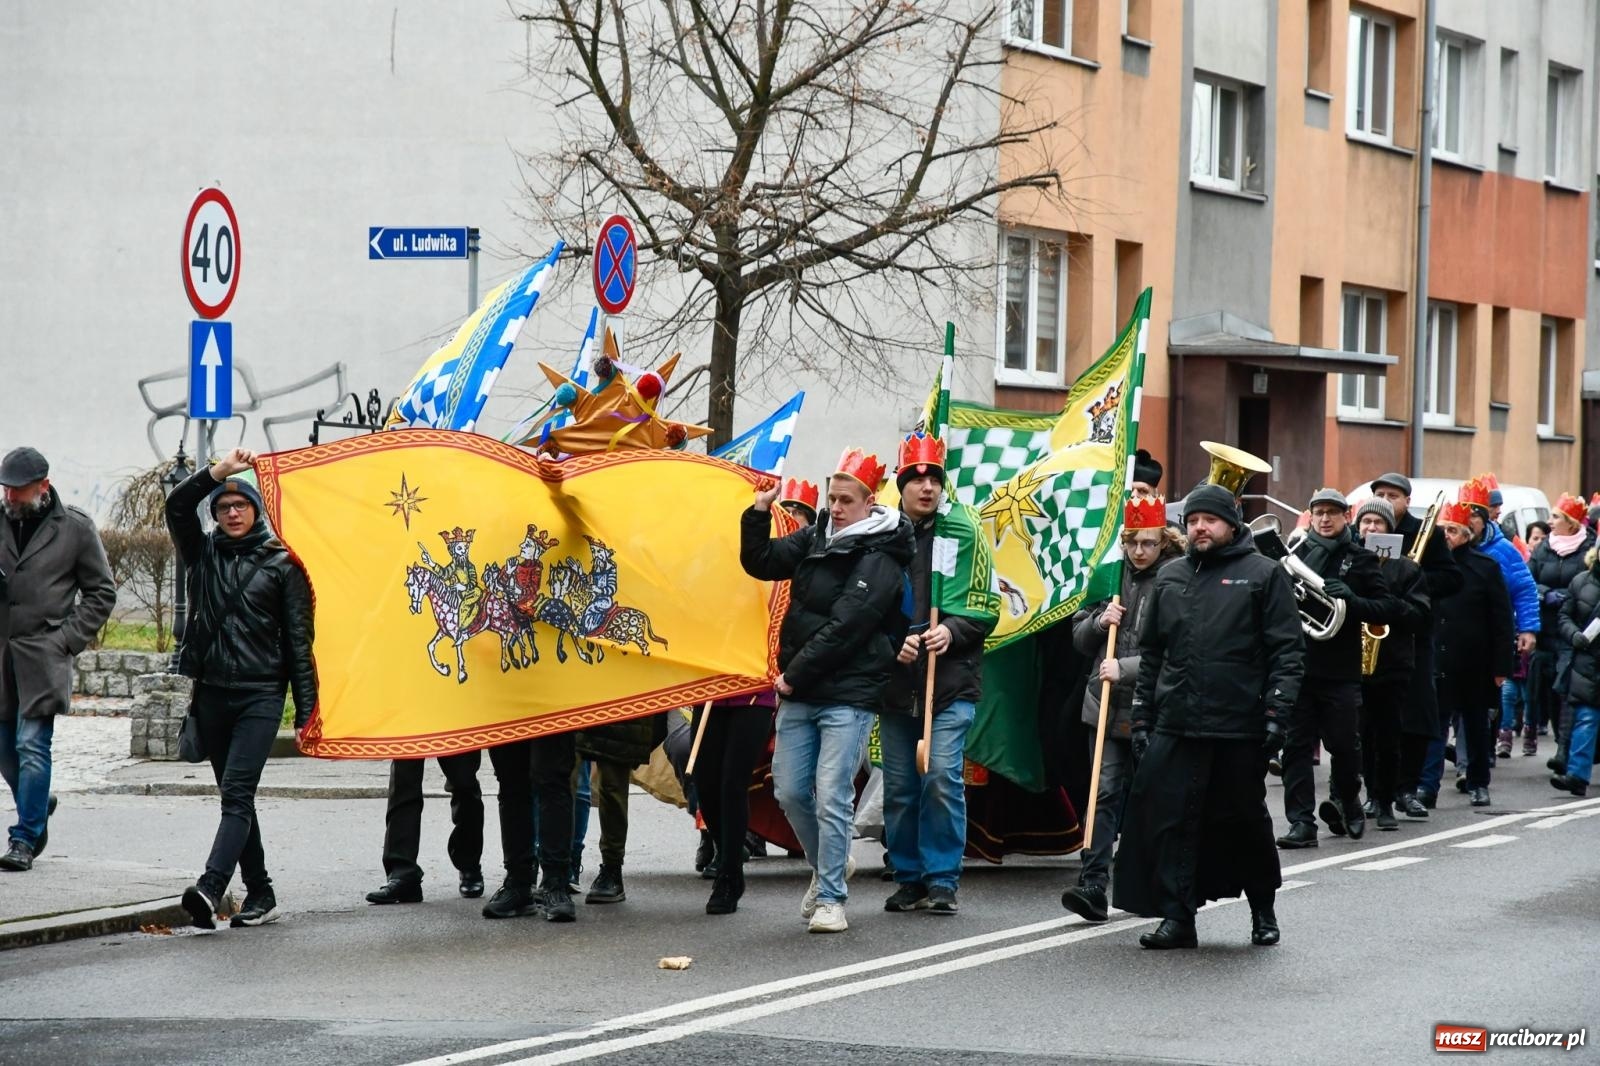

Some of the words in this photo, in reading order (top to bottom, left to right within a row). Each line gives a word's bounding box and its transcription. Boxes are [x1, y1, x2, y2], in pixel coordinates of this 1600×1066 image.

[192, 223, 233, 284] 40
[393, 233, 408, 251] ul.
[412, 233, 457, 251] Ludwika
